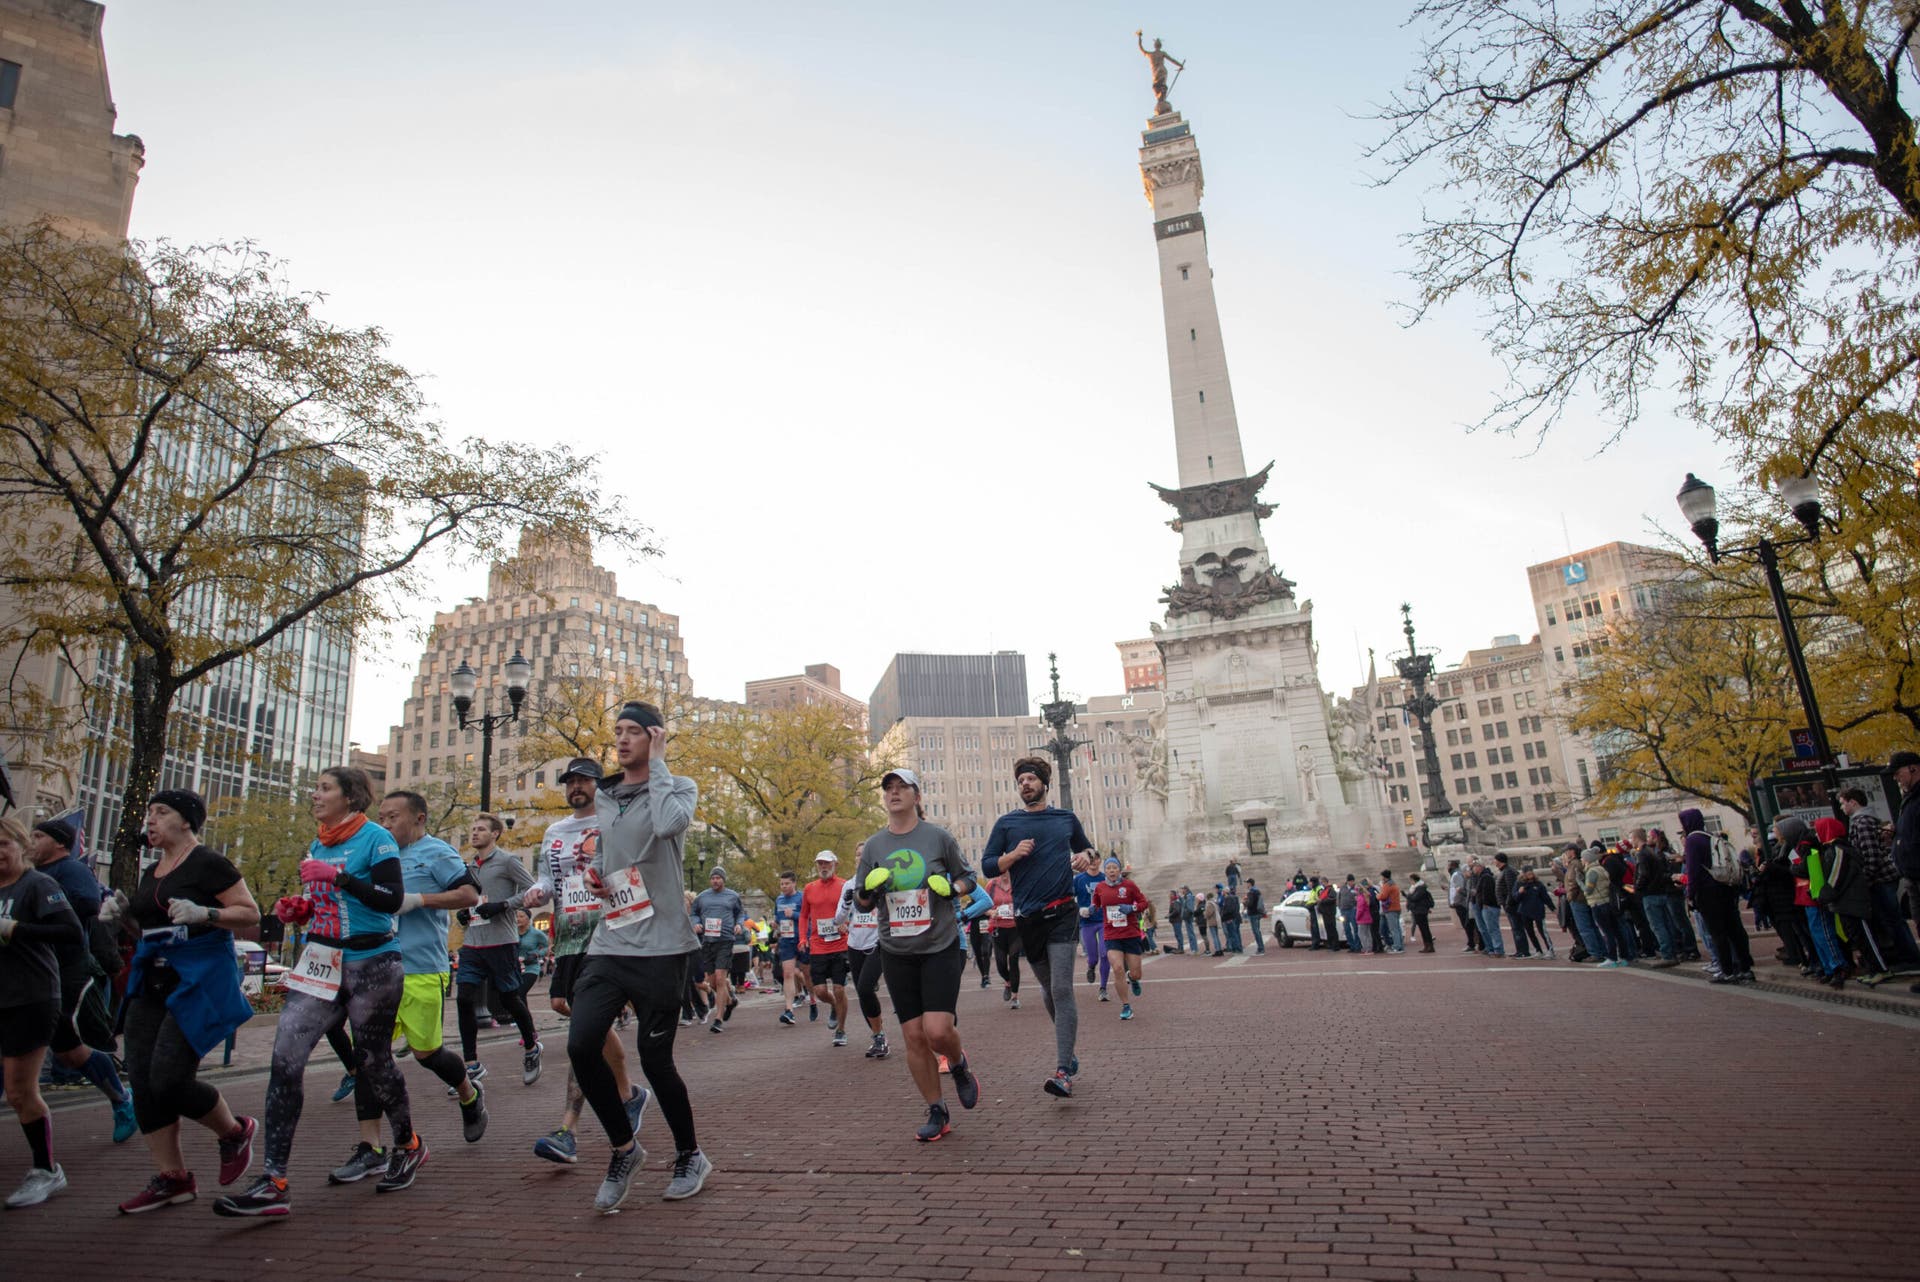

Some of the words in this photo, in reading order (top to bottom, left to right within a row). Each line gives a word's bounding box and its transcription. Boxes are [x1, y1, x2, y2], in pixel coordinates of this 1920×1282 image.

[1792, 759, 1821, 769] Indiana
[608, 887, 635, 908] 8101
[895, 905, 923, 919] 10939
[306, 960, 332, 979] 8677
